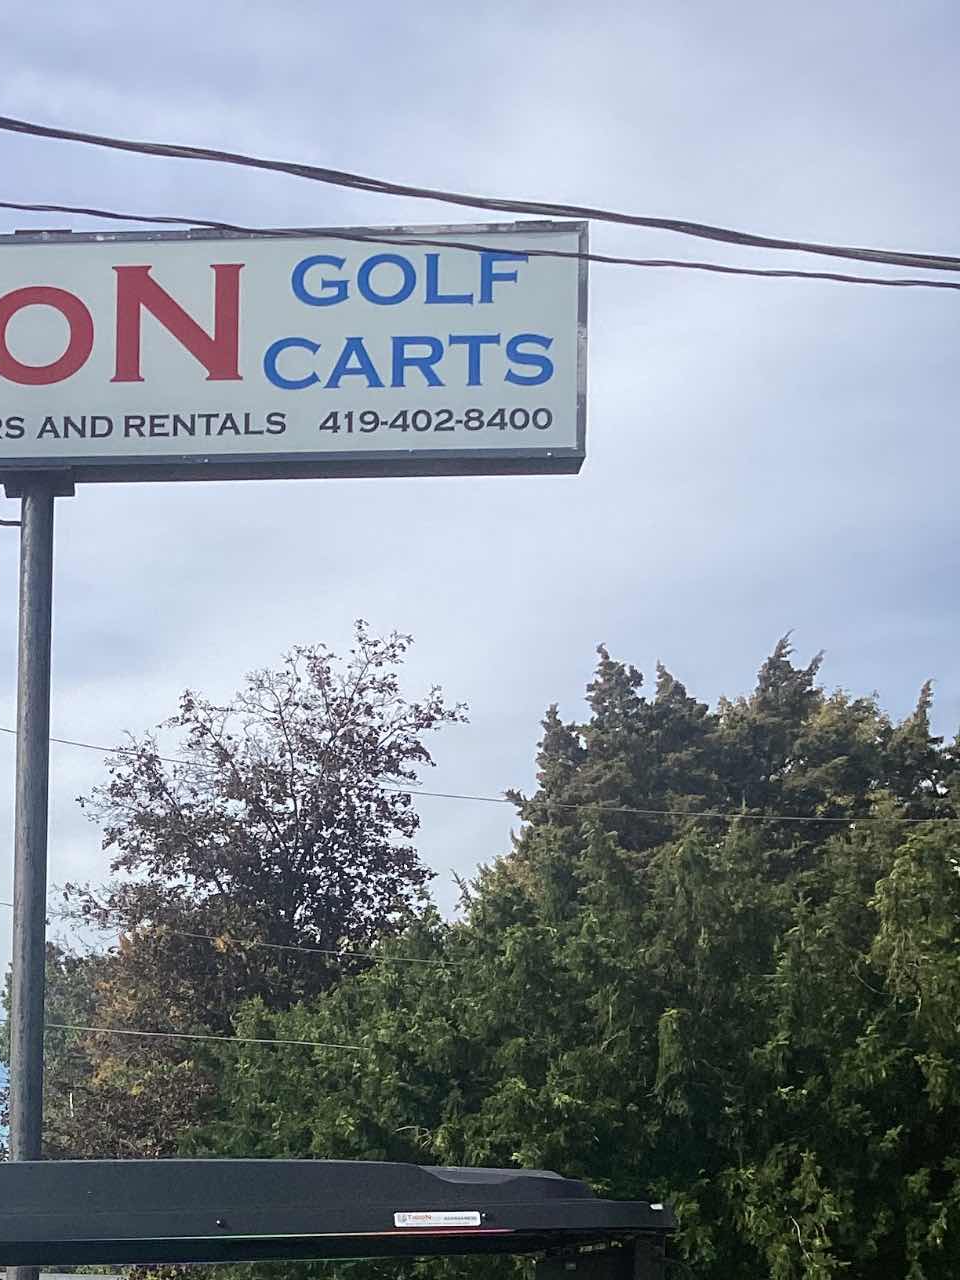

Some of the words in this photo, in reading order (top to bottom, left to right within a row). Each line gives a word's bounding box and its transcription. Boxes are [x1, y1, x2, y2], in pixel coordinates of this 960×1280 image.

[291, 252, 529, 307] GOLF
[263, 333, 554, 390] CARTS
[37, 415, 113, 439] AND
[123, 411, 287, 438] RENTALS
[319, 407, 553, 433] 419-402-8400
